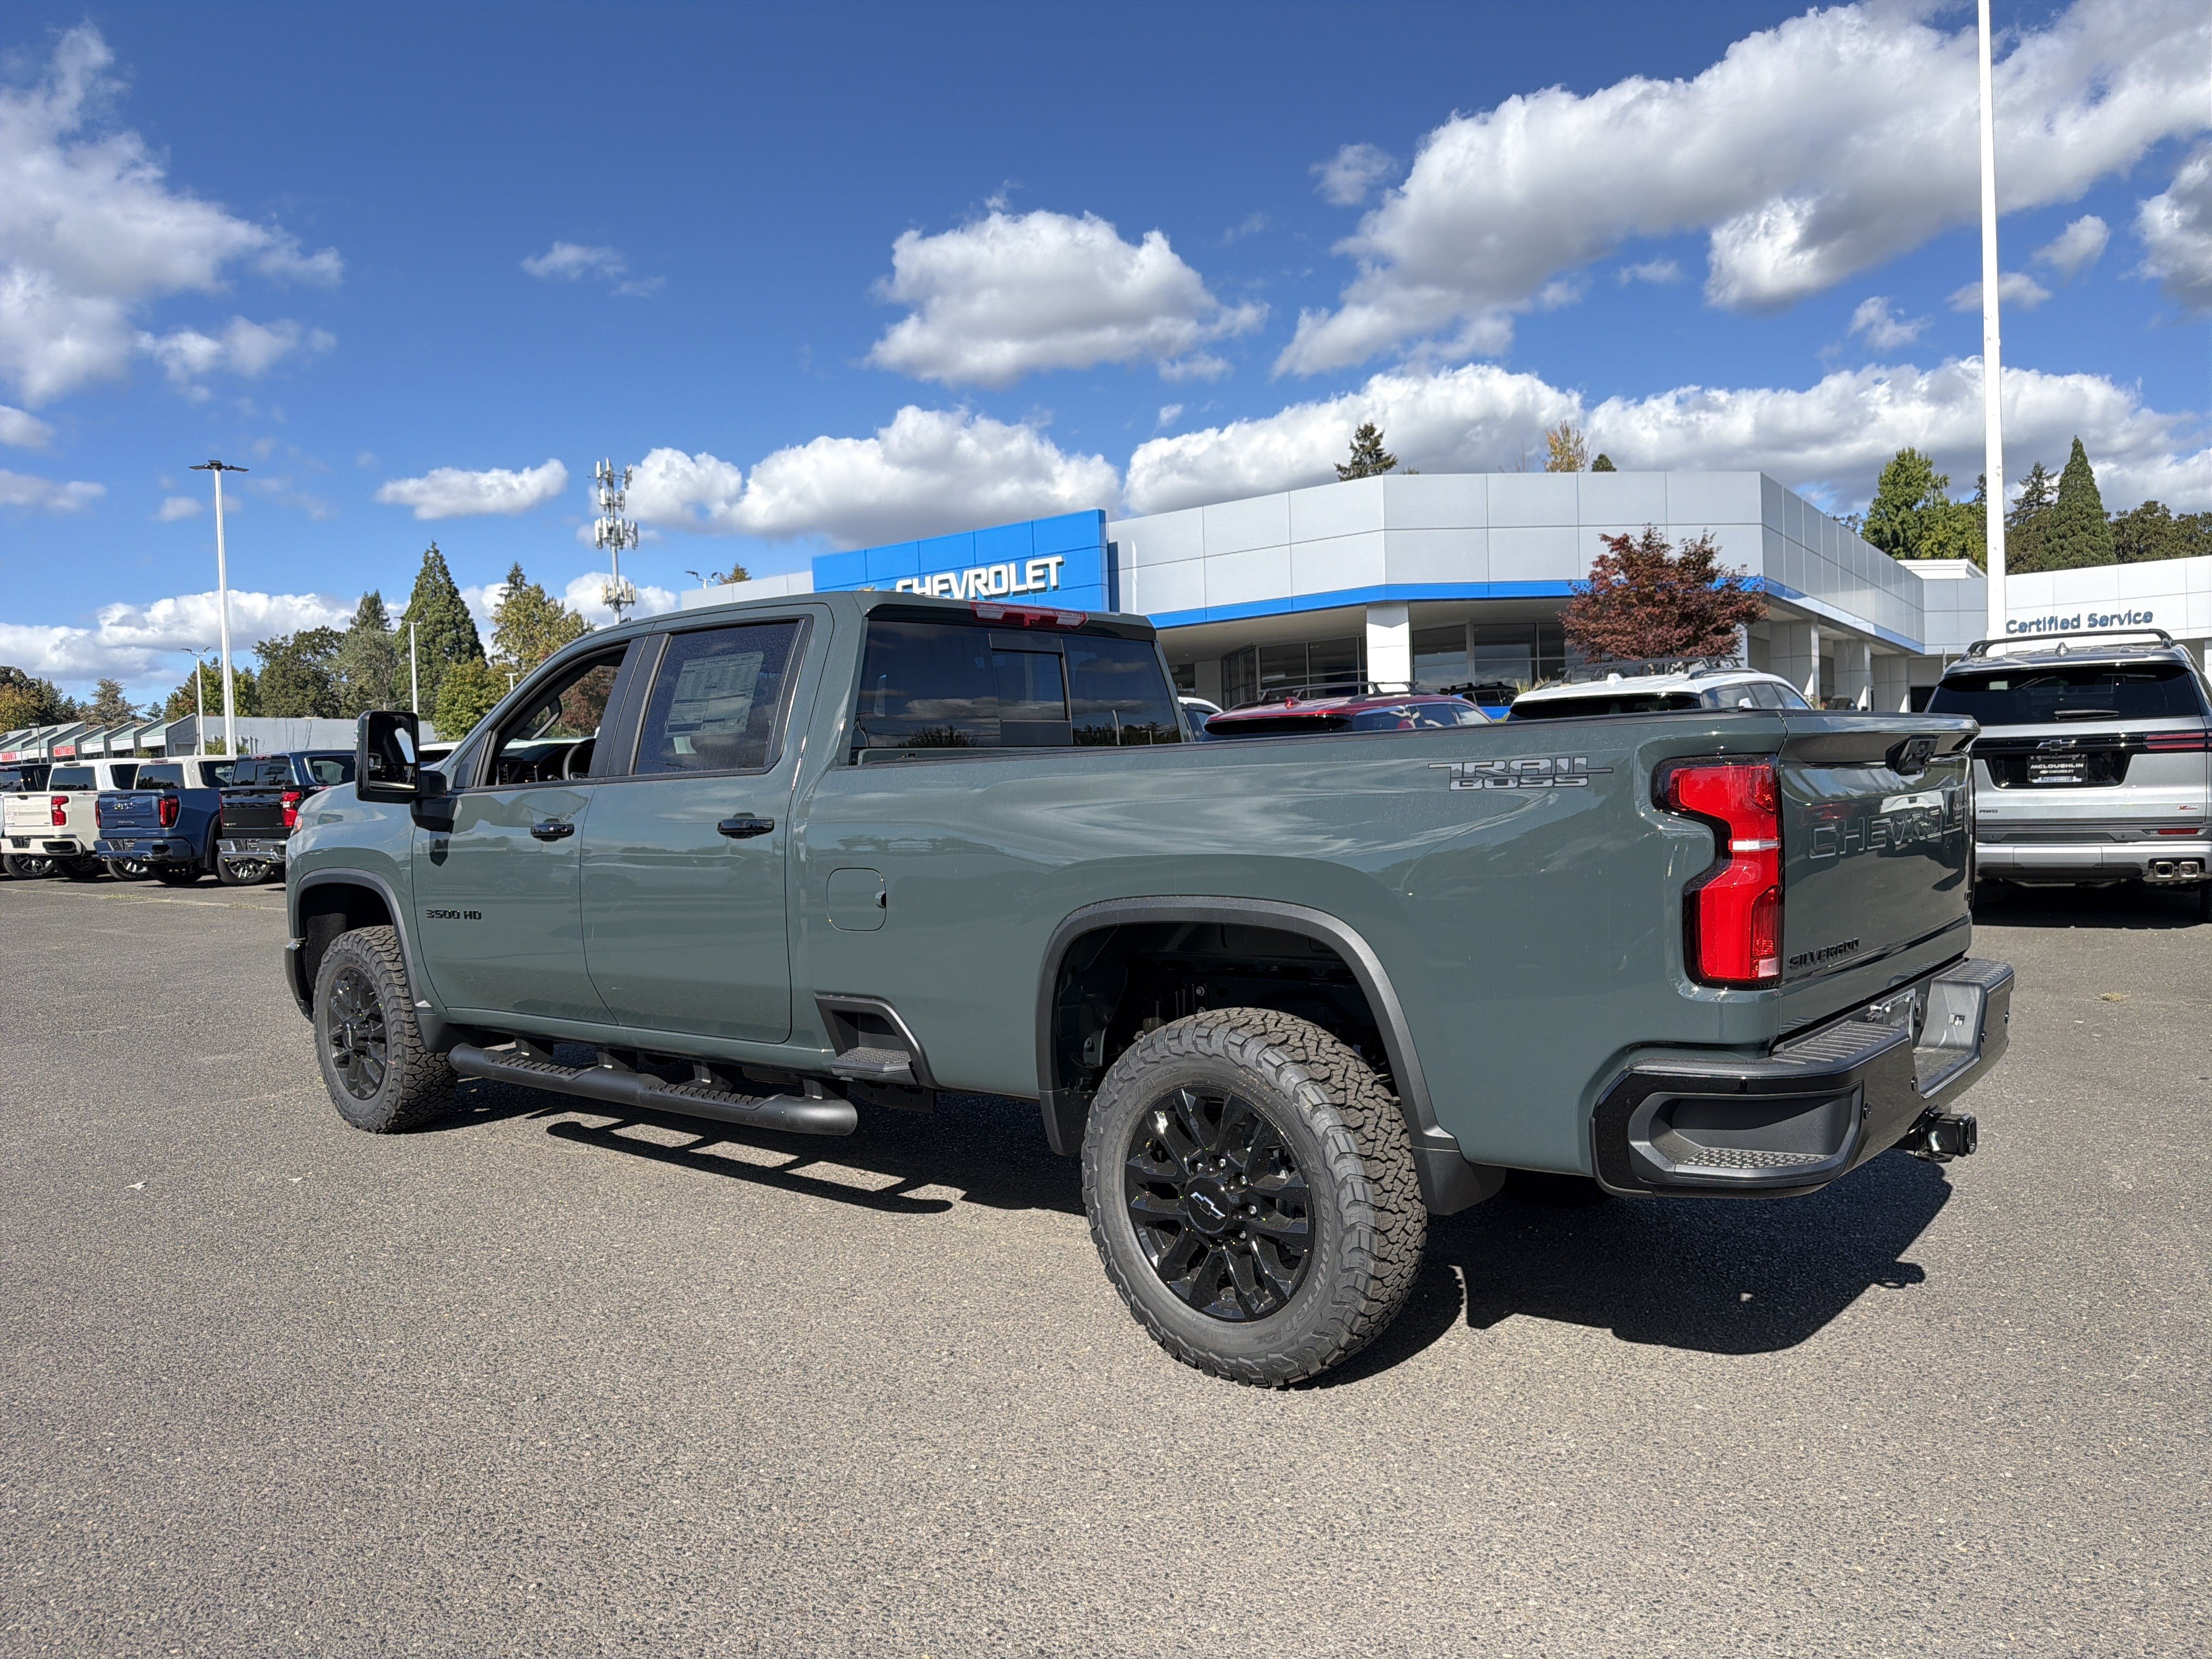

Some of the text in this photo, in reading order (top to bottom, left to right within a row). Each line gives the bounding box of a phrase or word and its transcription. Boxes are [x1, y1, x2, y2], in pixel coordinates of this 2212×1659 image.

[2006, 609, 2153, 634] Certified Service
[1449, 772, 1588, 791] BOSS
[426, 909, 482, 920] 3500 HD
[1788, 937, 1860, 969] SILVERADO
